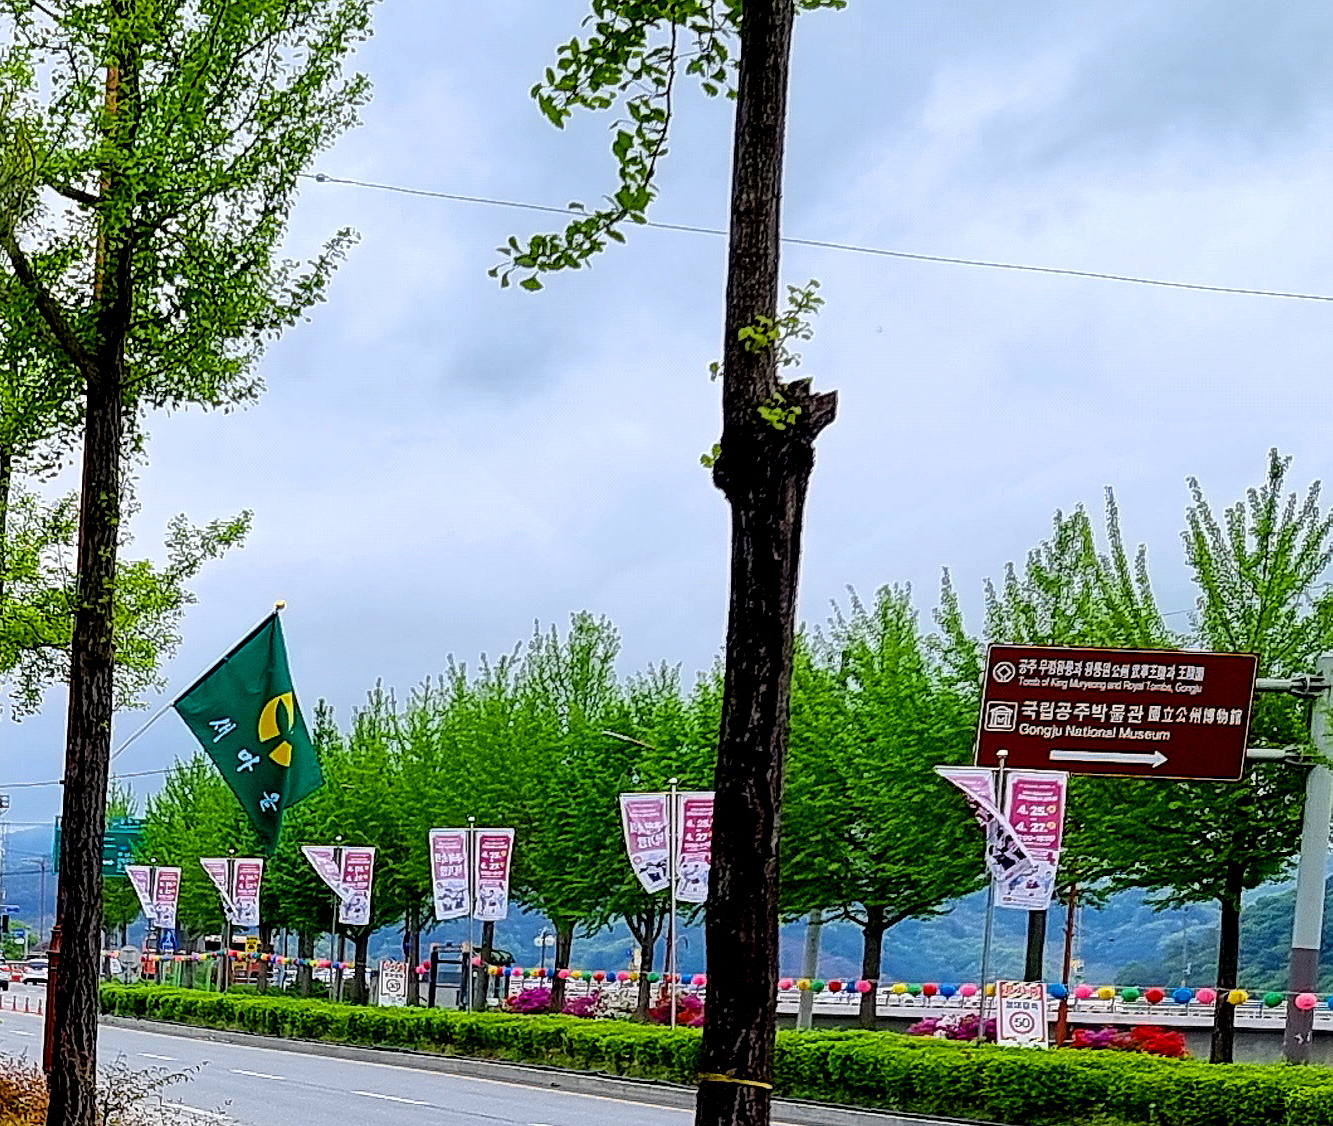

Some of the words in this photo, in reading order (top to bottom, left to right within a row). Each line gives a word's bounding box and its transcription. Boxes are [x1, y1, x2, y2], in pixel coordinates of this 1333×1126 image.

[1018, 659, 1037, 675] 공주
[1042, 677, 1050, 686] of
[1050, 678, 1068, 690] King
[1069, 679, 1106, 692] Muryeong
[1107, 681, 1122, 690] and
[1123, 681, 1144, 692] Royal
[1175, 682, 1203, 695] Gongju
[1020, 700, 1144, 724] 국립공주박물관
[1018, 723, 1063, 739] Gongju
[1065, 725, 1116, 738] National
[1118, 727, 1171, 740] Museum
[208, 716, 281, 813] 새마을
[1014, 1017, 1031, 1028] 50
